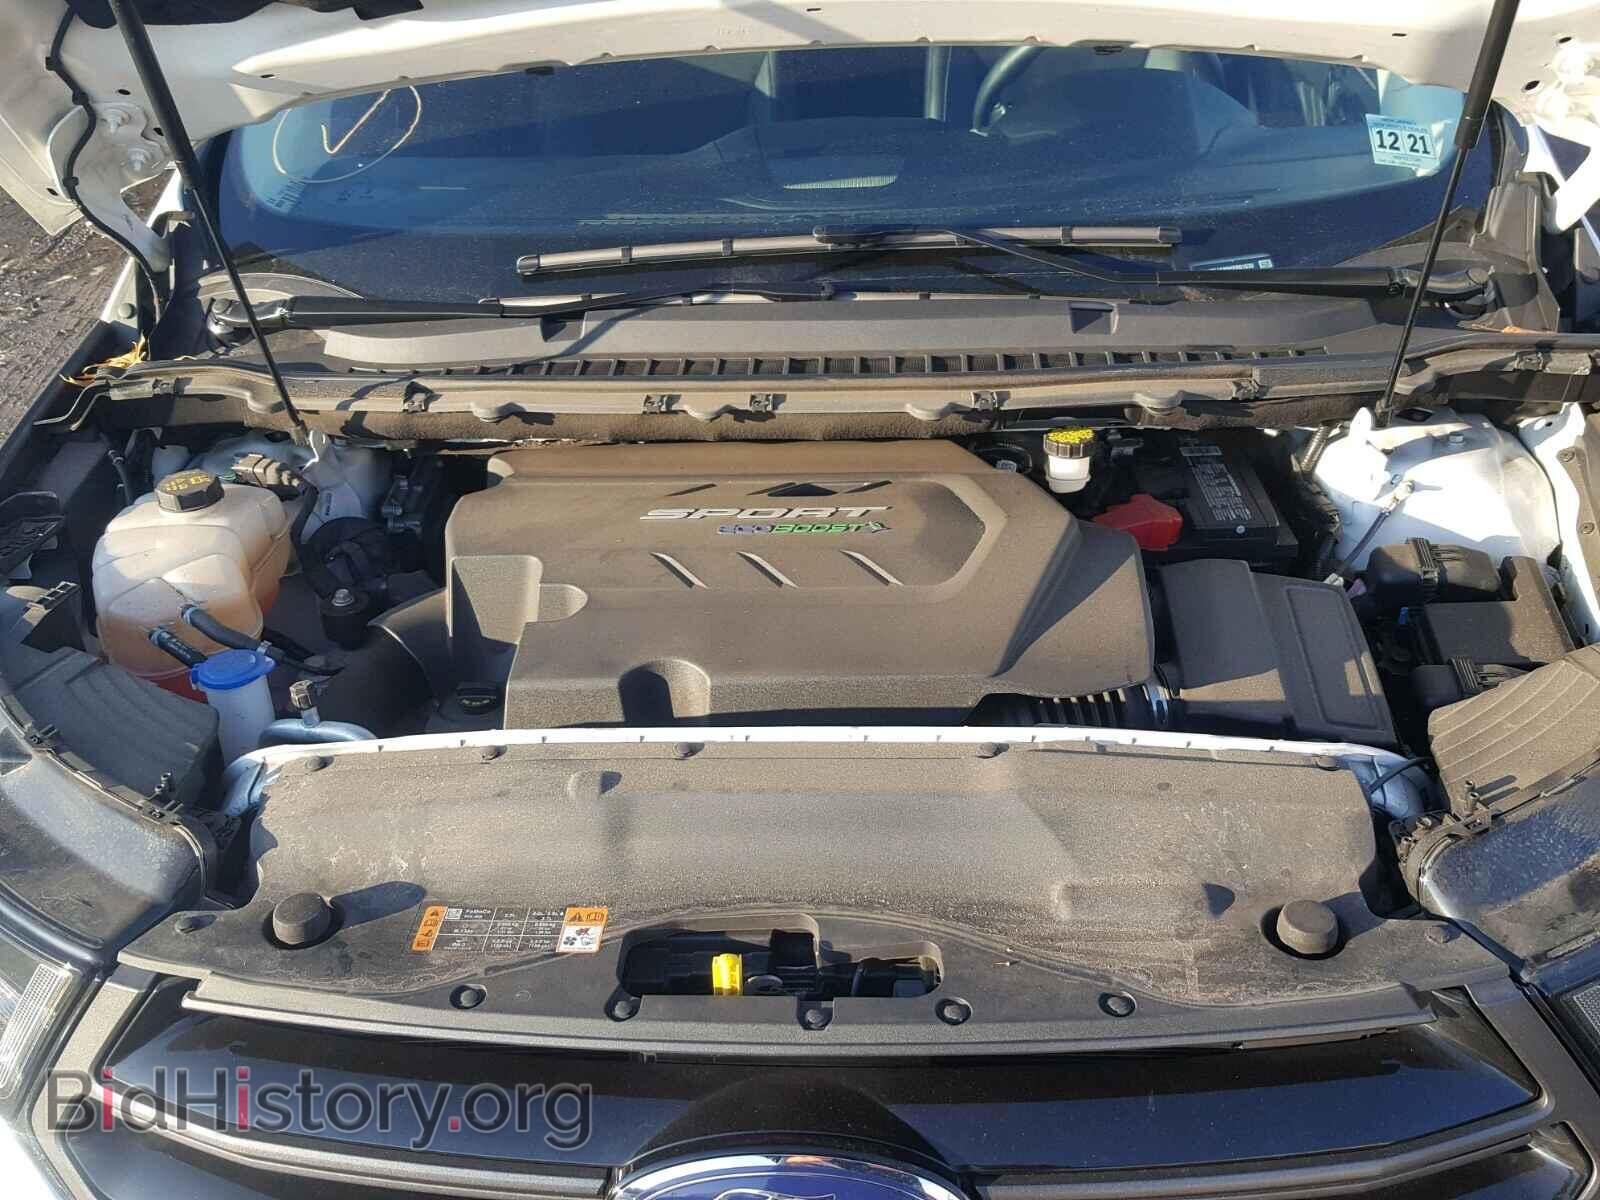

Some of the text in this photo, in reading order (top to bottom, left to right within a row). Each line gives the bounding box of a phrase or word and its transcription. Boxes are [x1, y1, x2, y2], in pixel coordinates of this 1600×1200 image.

[1376, 130, 1430, 155] 12 21
[639, 506, 889, 520] SPORT
